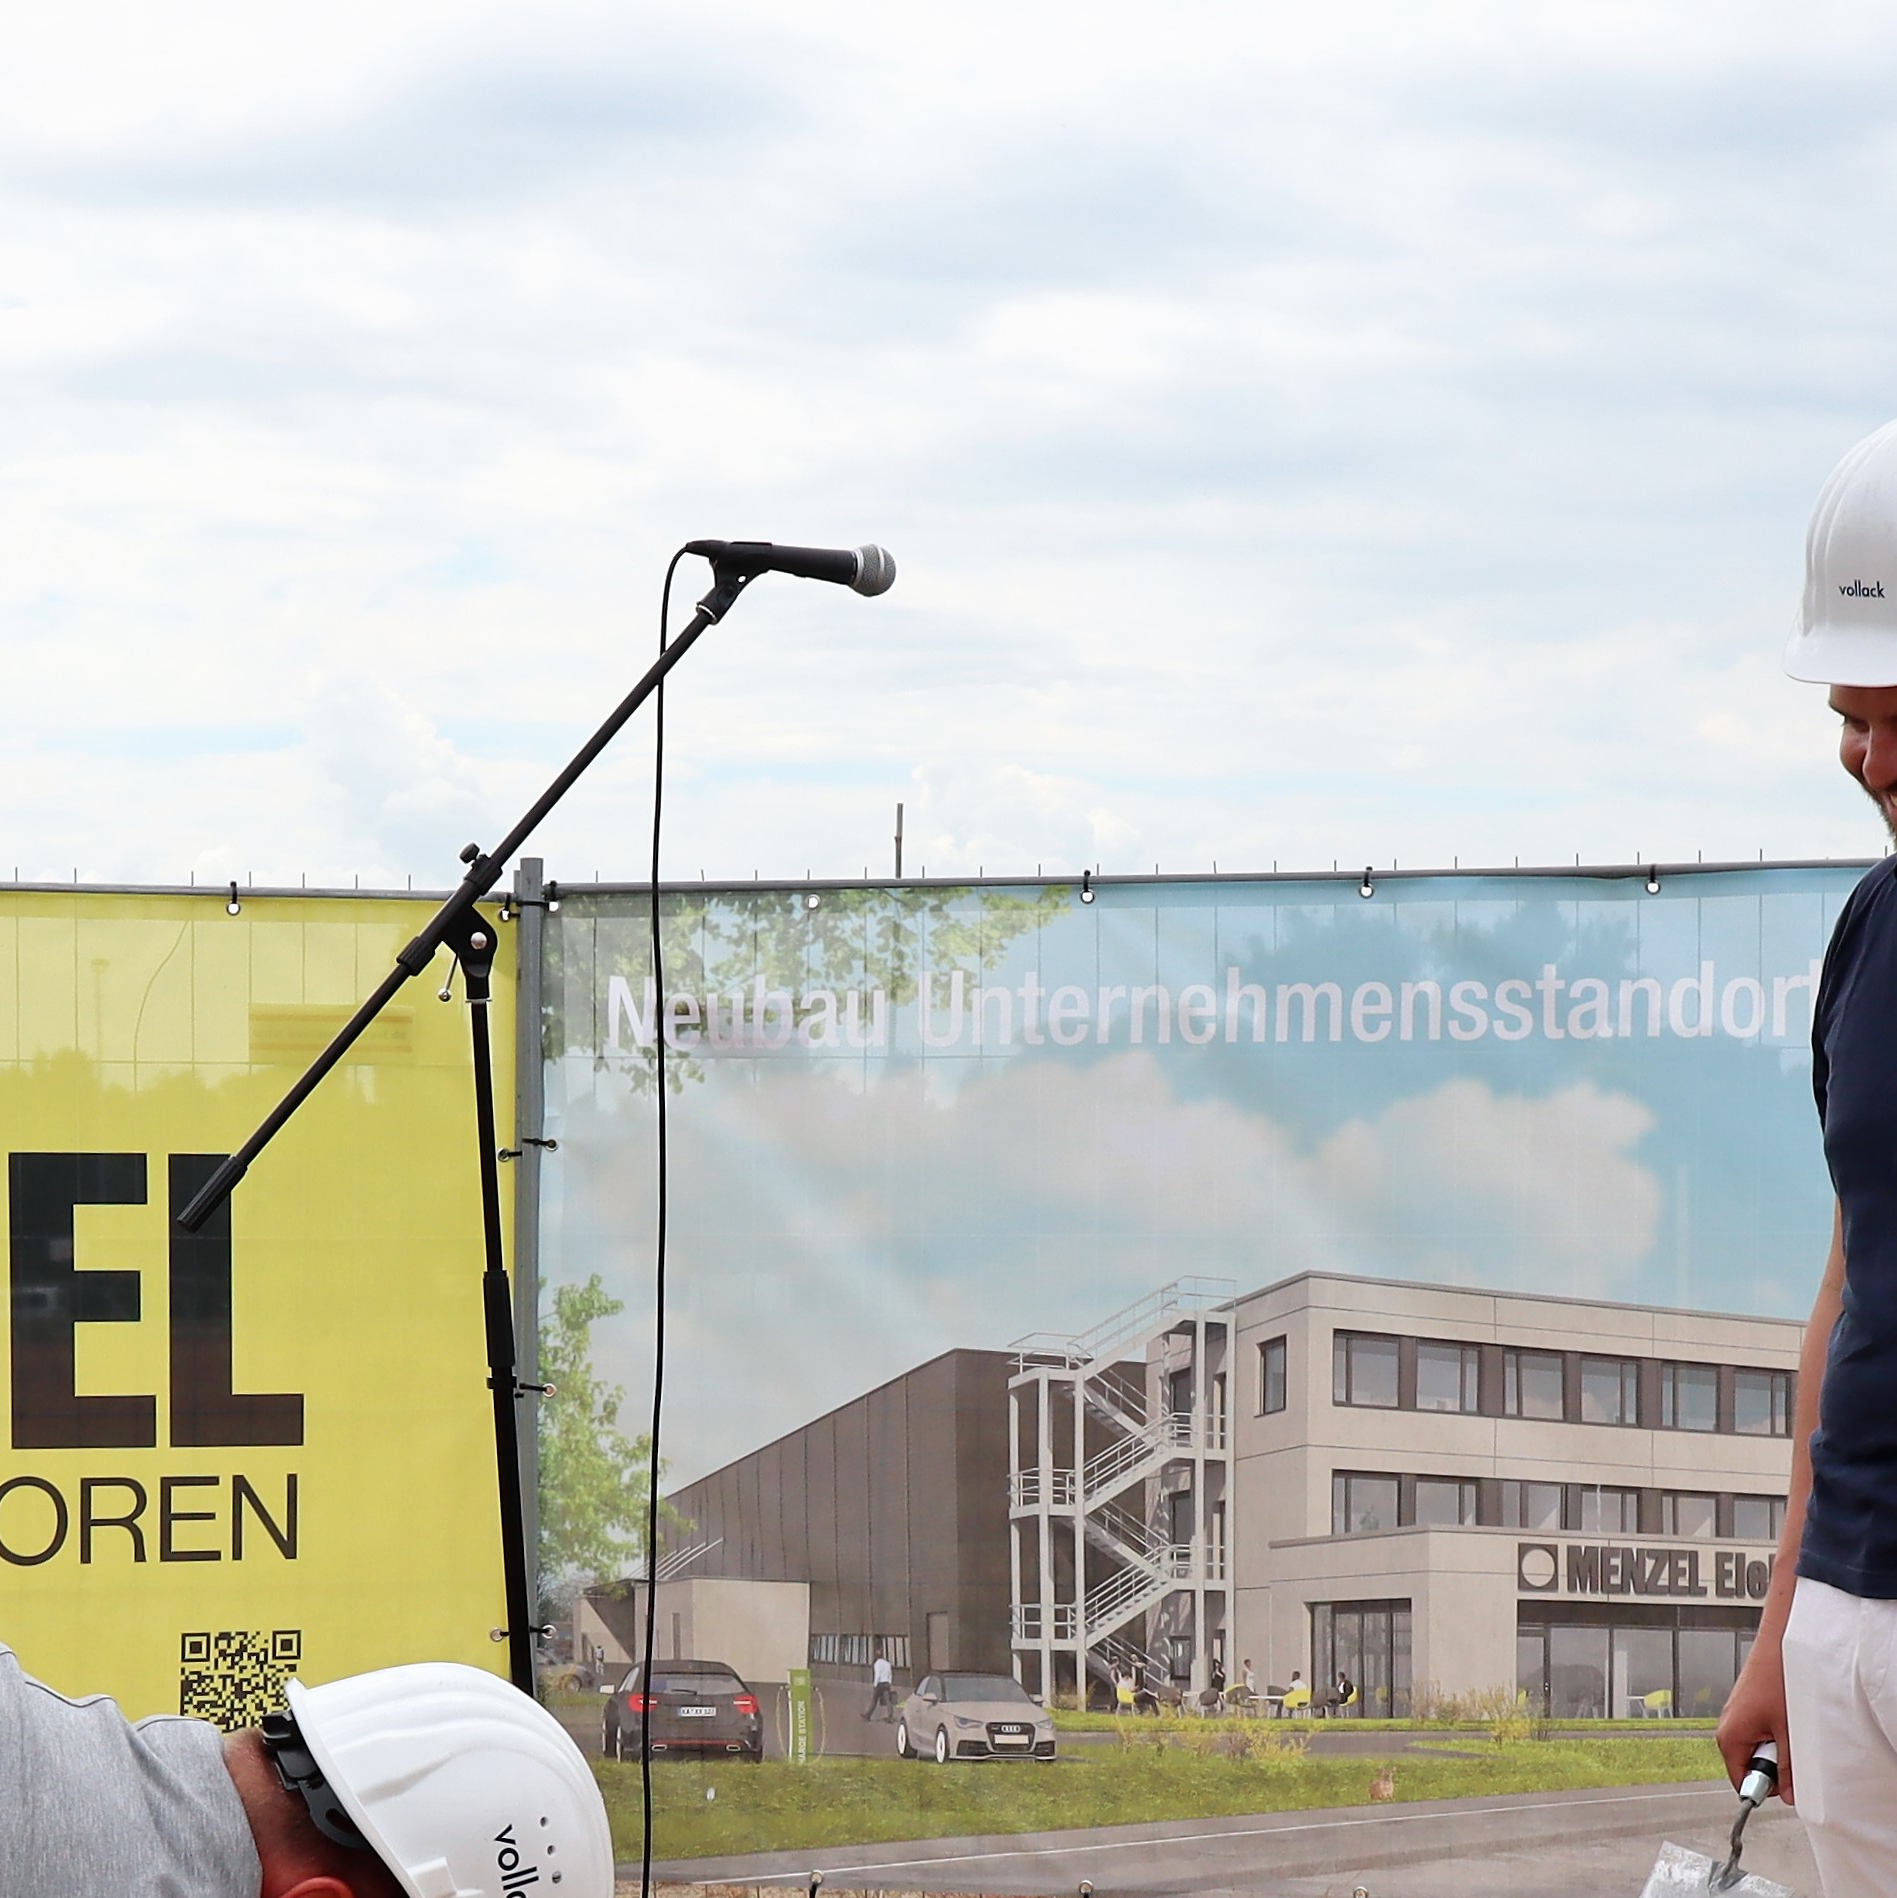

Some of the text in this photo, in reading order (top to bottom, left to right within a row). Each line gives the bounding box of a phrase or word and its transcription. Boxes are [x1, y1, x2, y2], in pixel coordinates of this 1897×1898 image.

[1839, 580, 1885, 599] vollack
[607, 973, 887, 1051] Neubau
[1566, 1545, 1708, 1596] MENZEL
